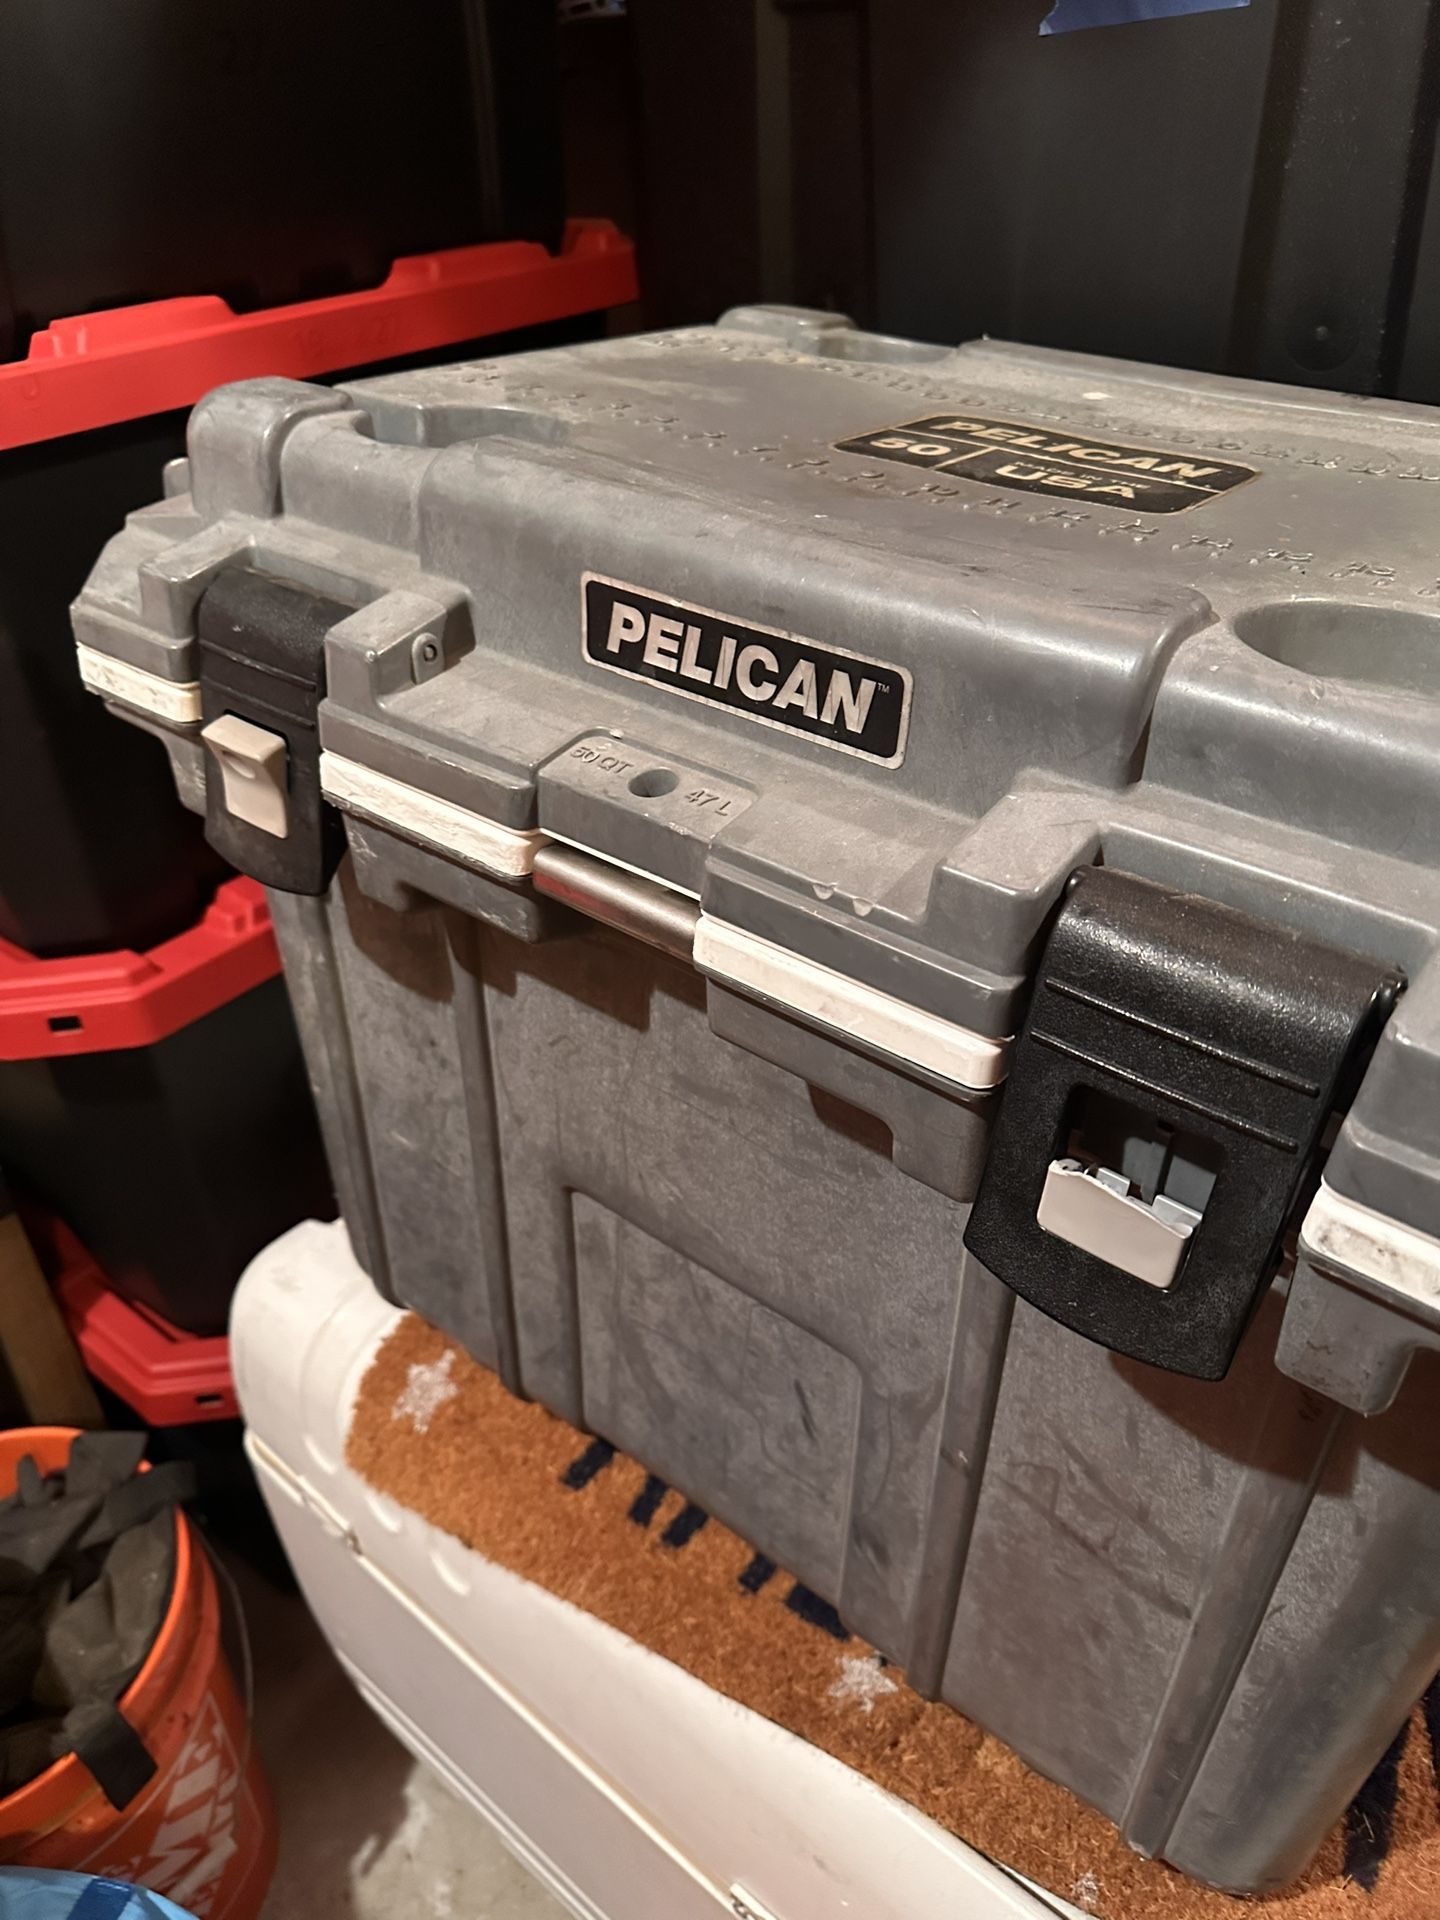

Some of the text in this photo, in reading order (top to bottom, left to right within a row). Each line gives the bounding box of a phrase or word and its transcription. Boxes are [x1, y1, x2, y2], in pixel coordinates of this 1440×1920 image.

[869, 437, 951, 456] 50
[929, 421, 1222, 478] PELICAN
[995, 464, 1135, 499] USA
[606, 601, 878, 734] PELICAN
[600, 756, 635, 774] QT
[684, 789, 731, 817] 47 L
